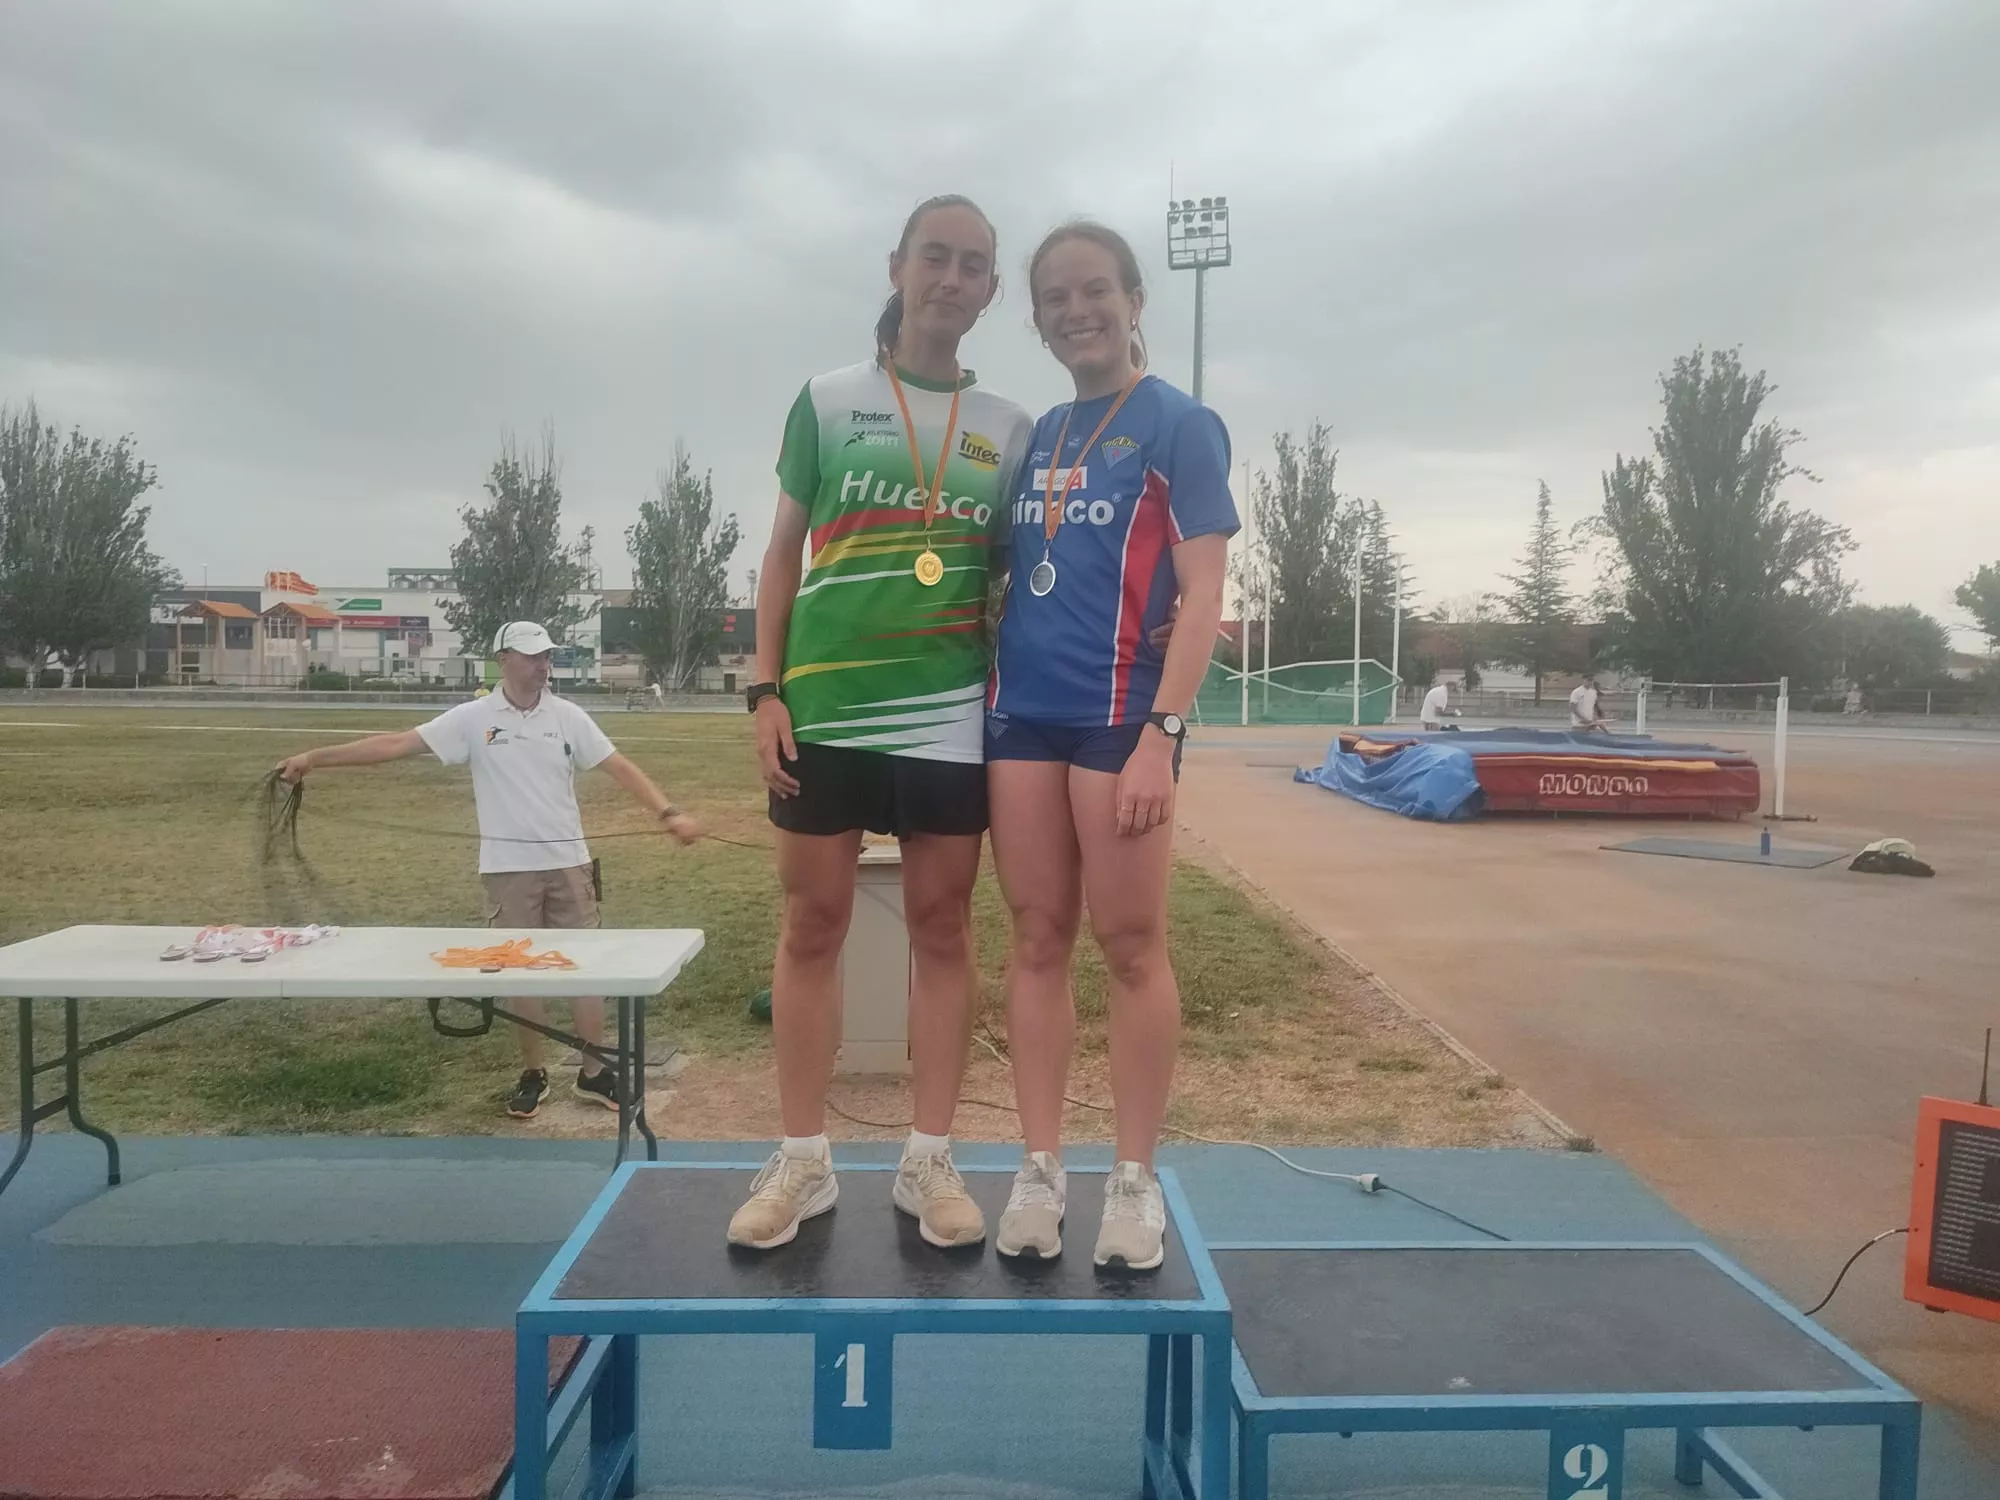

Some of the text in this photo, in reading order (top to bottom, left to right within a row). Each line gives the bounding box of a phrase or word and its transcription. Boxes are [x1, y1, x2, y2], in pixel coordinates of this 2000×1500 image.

[851, 410, 895, 422] Protex
[840, 470, 992, 528] Huesca
[1540, 773, 1649, 796] MONDO
[834, 1343, 868, 1407] 1
[1563, 1443, 1609, 1500] 2
